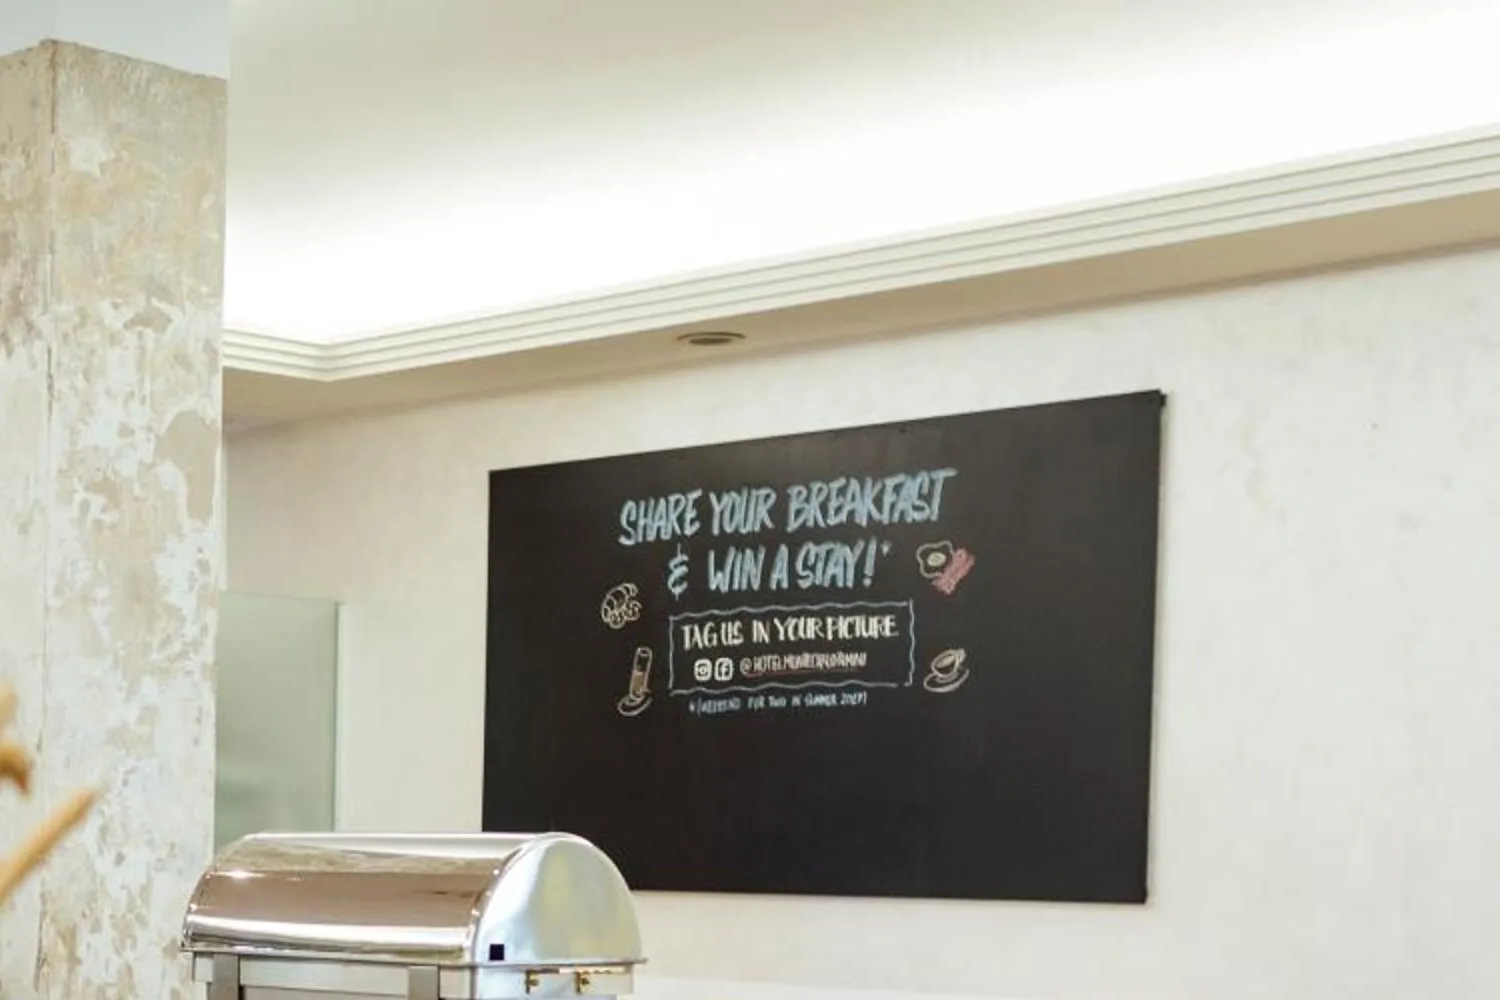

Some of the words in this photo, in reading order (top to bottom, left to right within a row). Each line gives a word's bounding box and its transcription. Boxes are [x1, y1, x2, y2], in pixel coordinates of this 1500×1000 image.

[618, 488, 703, 546] SHARE
[708, 486, 777, 536] YOUR
[786, 467, 958, 533] BREAKFAST
[667, 543, 689, 601] &
[708, 545, 766, 594] WIN
[769, 544, 789, 590] A
[681, 621, 718, 651] TAG
[721, 620, 744, 646] US
[751, 619, 770, 644] IN
[773, 616, 825, 641] YOUR
[825, 614, 900, 641] PICTURE
